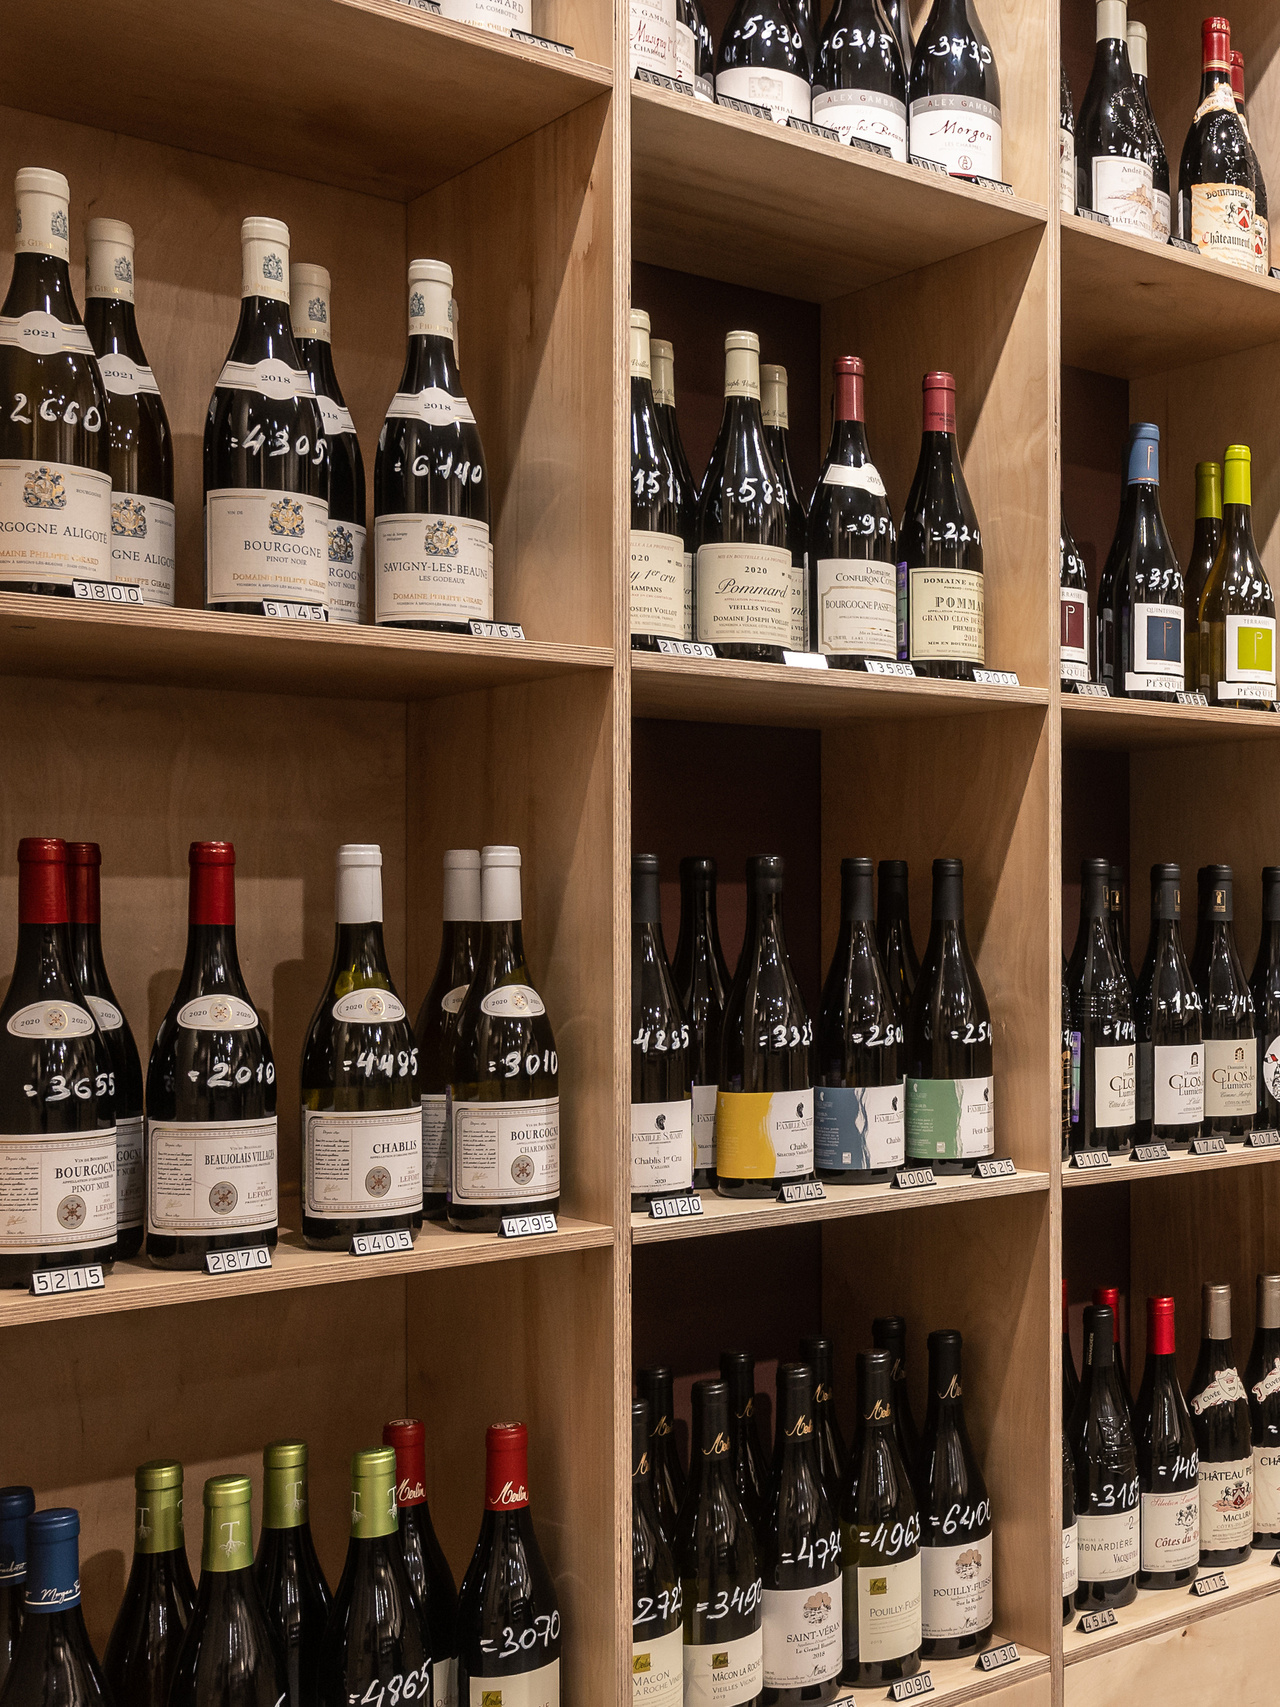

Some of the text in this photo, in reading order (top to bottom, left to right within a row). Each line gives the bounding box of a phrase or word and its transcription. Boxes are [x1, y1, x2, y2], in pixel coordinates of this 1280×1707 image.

[640, 70, 694, 97] 38295
[720, 98, 772, 121] 15125
[827, 94, 900, 111] ALEX GAMBAL
[961, 100, 998, 116] GAMBAL
[930, 120, 992, 142] Morgon
[912, 157, 948, 176] 9015
[980, 179, 1013, 195] 5330
[23, 329, 56, 338] 2021
[104, 370, 134, 380] 2021
[261, 375, 291, 384] 2018
[424, 402, 451, 411] 2018
[63, 527, 107, 544] ALIGOTÉ
[244, 540, 321, 558] BOURGOGNE
[291, 558, 307, 566] NOIR
[384, 562, 487, 580] SAVIGNY-LES-BEAUNE
[745, 566, 768, 574] 2020
[151, 580, 170, 589] GIRARD
[233, 573, 307, 585] DOMAINE PHILIPPE
[433, 576, 465, 584] GODEAUX
[836, 573, 880, 585] CONFURON
[78, 584, 139, 601] 3800
[715, 577, 788, 598] Pommard
[266, 603, 322, 619] 6145
[761, 606, 781, 614] VIGNES
[826, 600, 872, 609] BOURGOGNE
[746, 616, 770, 624] JOSEPH
[952, 615, 968, 623] CLOS
[473, 623, 521, 638] 8765
[952, 624, 976, 632] PREMIER
[660, 641, 713, 657] 21690
[868, 662, 913, 676] 13585
[976, 671, 1017, 685] 32000
[1078, 684, 1108, 697] 2815
[1178, 693, 1206, 705] 5065
[492, 998, 508, 1006] 2020
[189, 1009, 251, 1019] 2020 2020
[20, 1018, 88, 1027] 2020 2020
[1168, 1074, 1201, 1090] CLOS
[1211, 1068, 1248, 1084] CLOS
[1221, 1081, 1252, 1091] Lumières
[886, 1137, 901, 1145] Chablis
[1196, 1139, 1225, 1151] 1740
[1252, 1132, 1279, 1145] 2075
[373, 1139, 417, 1154] CHABLIS
[1137, 1146, 1168, 1160] 2055
[205, 1152, 251, 1165] BEAUJOLAIS
[634, 1155, 662, 1165] Chablis
[1077, 1153, 1108, 1167] 3100
[983, 1161, 1015, 1175] 3625
[900, 1171, 933, 1185] 4000
[71, 1181, 110, 1194] PINOT NOIR
[247, 1189, 272, 1199] LEFORT
[786, 1184, 823, 1199] 4745
[654, 1198, 701, 1215] 6120
[506, 1213, 554, 1233] 4295
[357, 1232, 410, 1252] 6405
[210, 1250, 268, 1272] 2870
[37, 1269, 101, 1291] 5215
[1202, 1389, 1222, 1403] CUVÉE
[489, 1481, 528, 1505] Merlin
[1078, 1537, 1133, 1552] MONARDIÈRE
[1155, 1535, 1192, 1549] Côtes du
[1198, 1575, 1226, 1594] 2115
[1085, 1609, 1115, 1630] 4545
[787, 1620, 840, 1643] SAINT-VÉRAN
[983, 1646, 1017, 1667] 9130
[712, 1667, 746, 1682] MÂCON LA
[643, 1681, 668, 1695] ROCHE
[712, 1684, 738, 1694] VIEILLES
[895, 1675, 932, 1698] 7090
